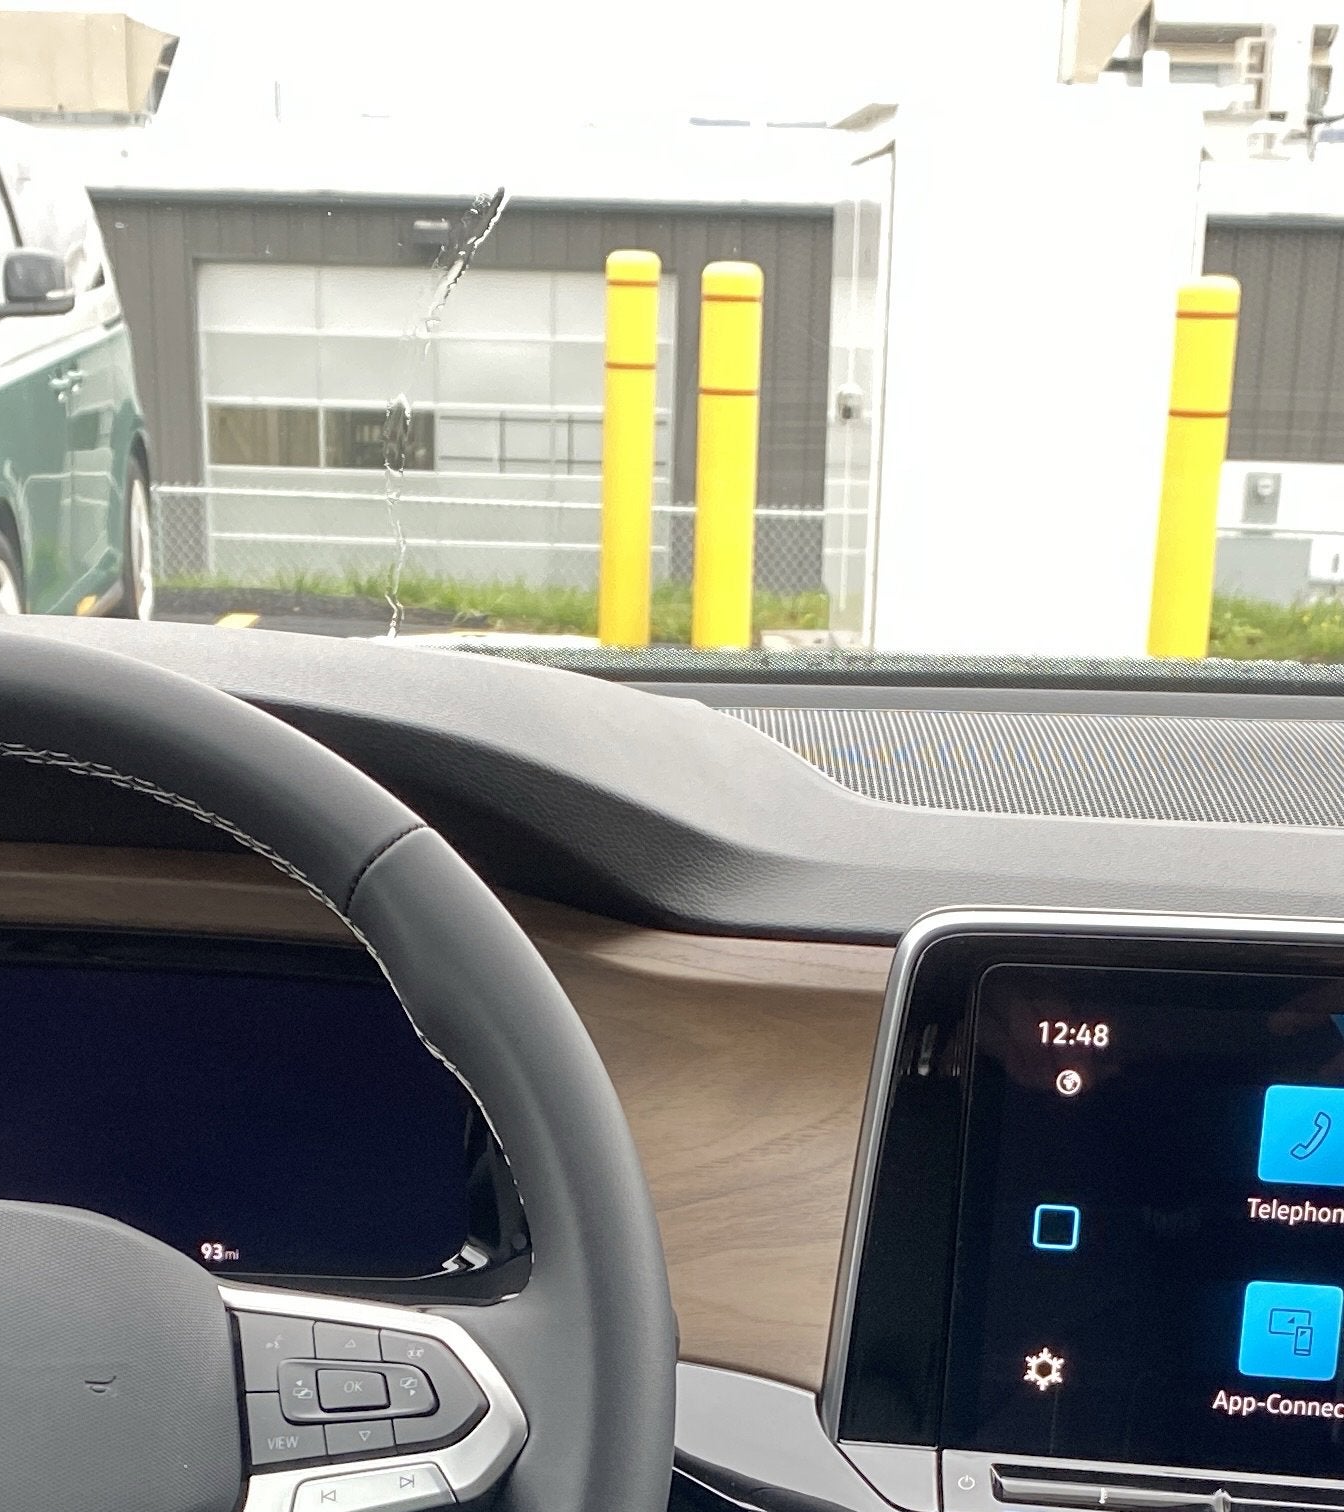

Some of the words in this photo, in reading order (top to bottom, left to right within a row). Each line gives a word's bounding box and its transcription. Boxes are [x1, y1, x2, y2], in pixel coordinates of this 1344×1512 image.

[1038, 1021, 1110, 1047] 12:48
[200, 1242, 223, 1260] 93
[225, 1249, 240, 1260] mi
[343, 1380, 364, 1393] OK
[267, 1436, 299, 1450] VIEW
